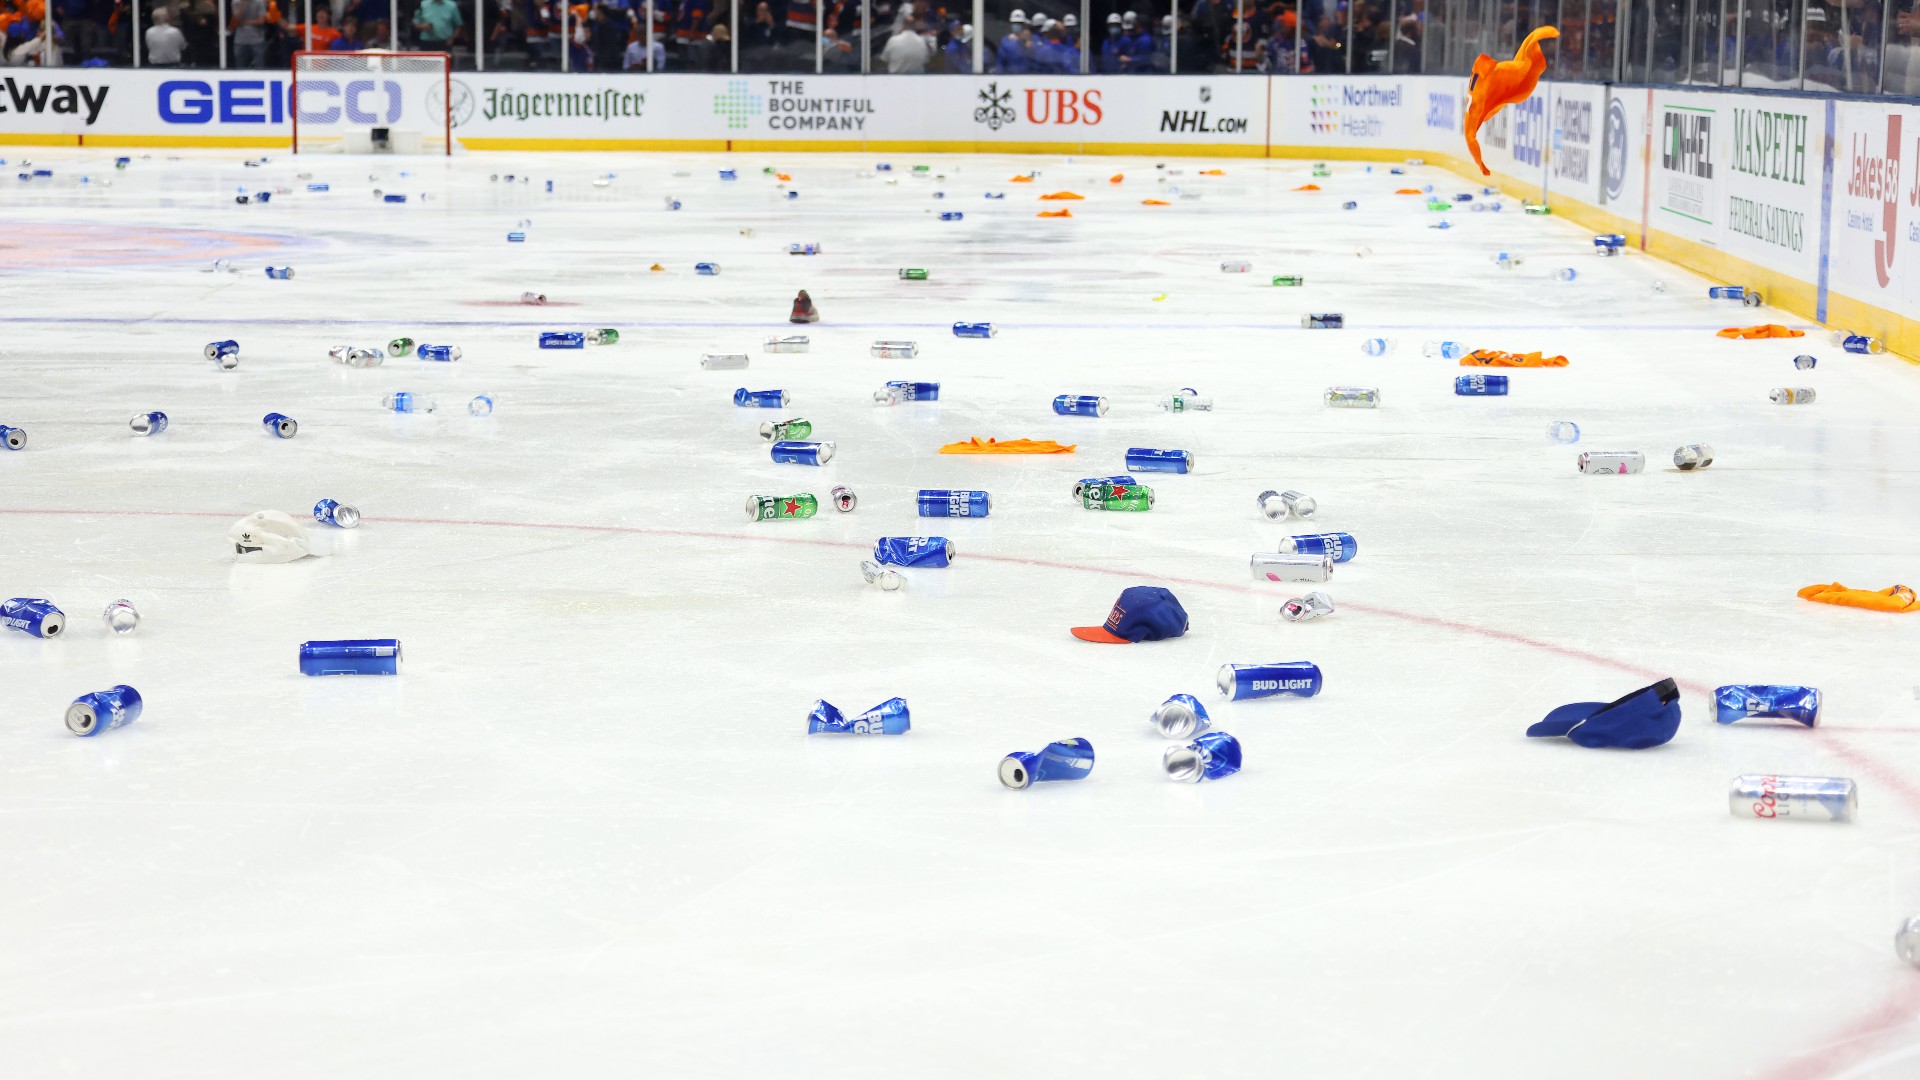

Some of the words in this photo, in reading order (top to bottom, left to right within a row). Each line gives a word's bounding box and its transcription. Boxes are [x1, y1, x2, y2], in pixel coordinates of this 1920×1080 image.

[769, 81, 804, 95] THE
[1343, 84, 1402, 106] Northwell
[157, 80, 402, 124] GEICO
[769, 99, 875, 113] BOUNTIFUL
[1024, 89, 1103, 125] UBS
[769, 116, 866, 130] COMPANY
[1160, 110, 1247, 132] NHL.COM
[1342, 114, 1383, 137] Health
[1731, 108, 1808, 185] MASPETH
[1848, 132, 1883, 200] Jake's
[1884, 158, 1899, 204] 58
[1729, 195, 1763, 239] FEDERAL
[1765, 204, 1804, 253] SAVINGS
[960, 491, 971, 516] BUD
[1252, 680, 1278, 691] BUD
[1279, 678, 1313, 690] LIGHT
